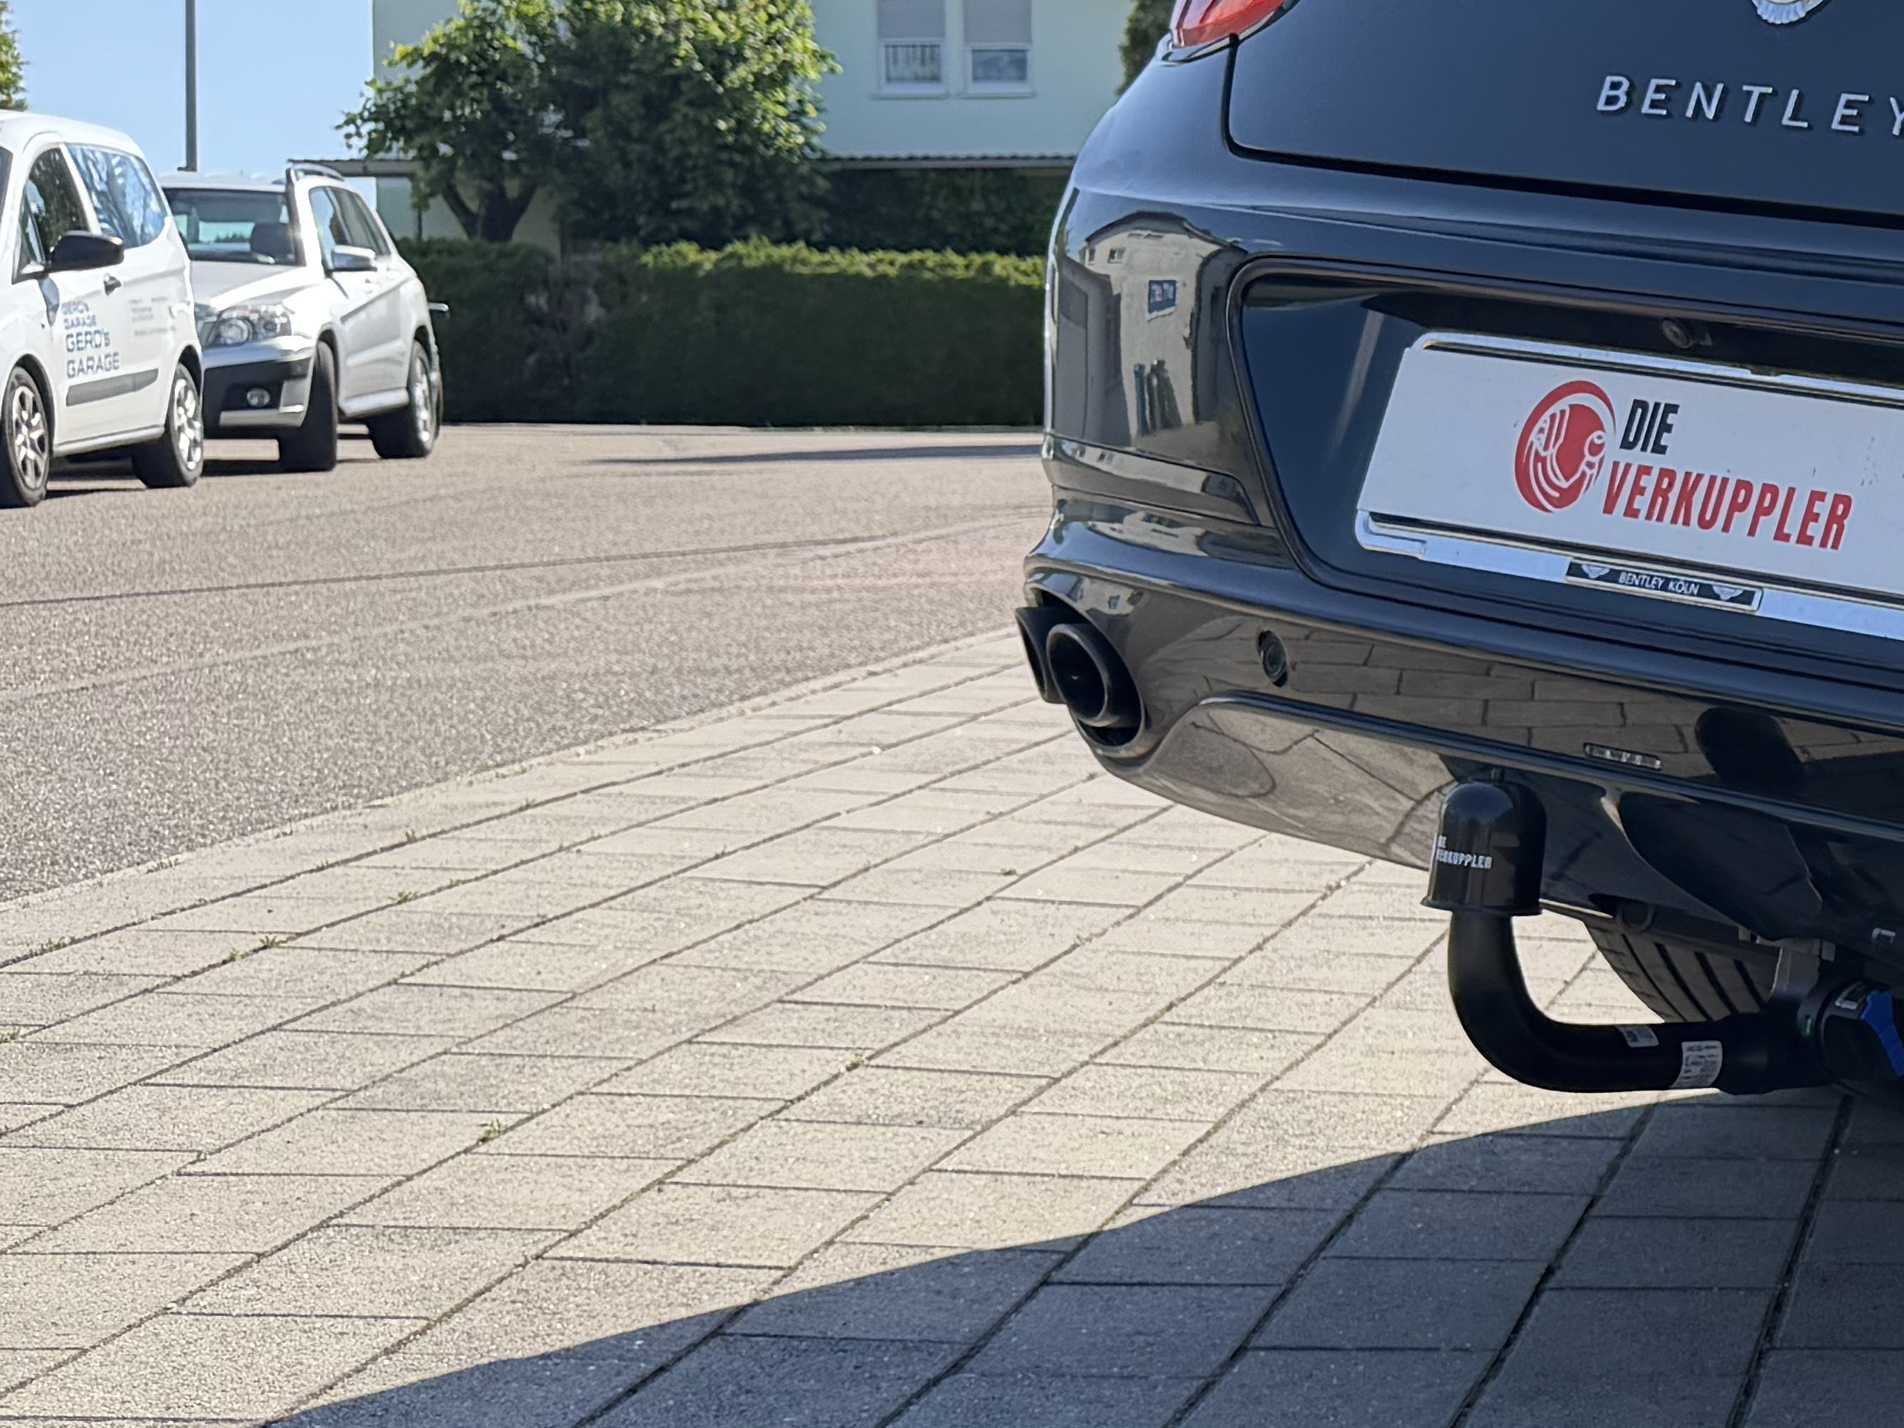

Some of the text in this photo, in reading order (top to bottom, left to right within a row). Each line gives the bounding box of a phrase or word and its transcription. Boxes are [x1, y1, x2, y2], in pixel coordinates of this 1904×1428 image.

[66, 351, 120, 379] GARAGE
[1619, 398, 1680, 455] DIE
[1602, 460, 1853, 551] VERKUPPLER
[1618, 571, 1700, 595] BENTLEY KÖLN
